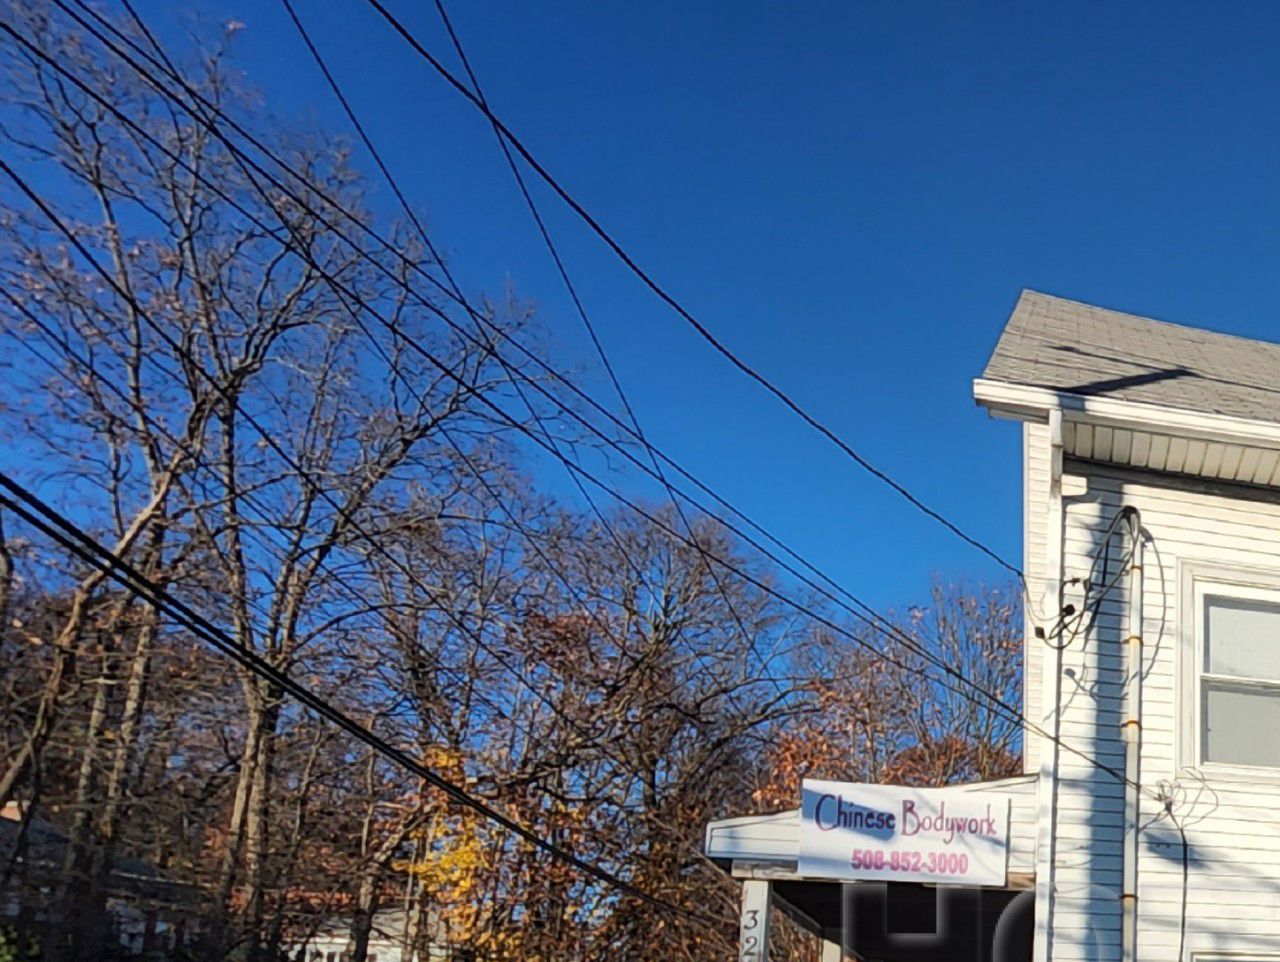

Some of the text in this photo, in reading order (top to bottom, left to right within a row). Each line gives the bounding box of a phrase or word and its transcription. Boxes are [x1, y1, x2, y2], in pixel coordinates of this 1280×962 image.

[815, 793, 998, 844] Chinese Bodywork
[850, 849, 969, 874] 508-852-3000
